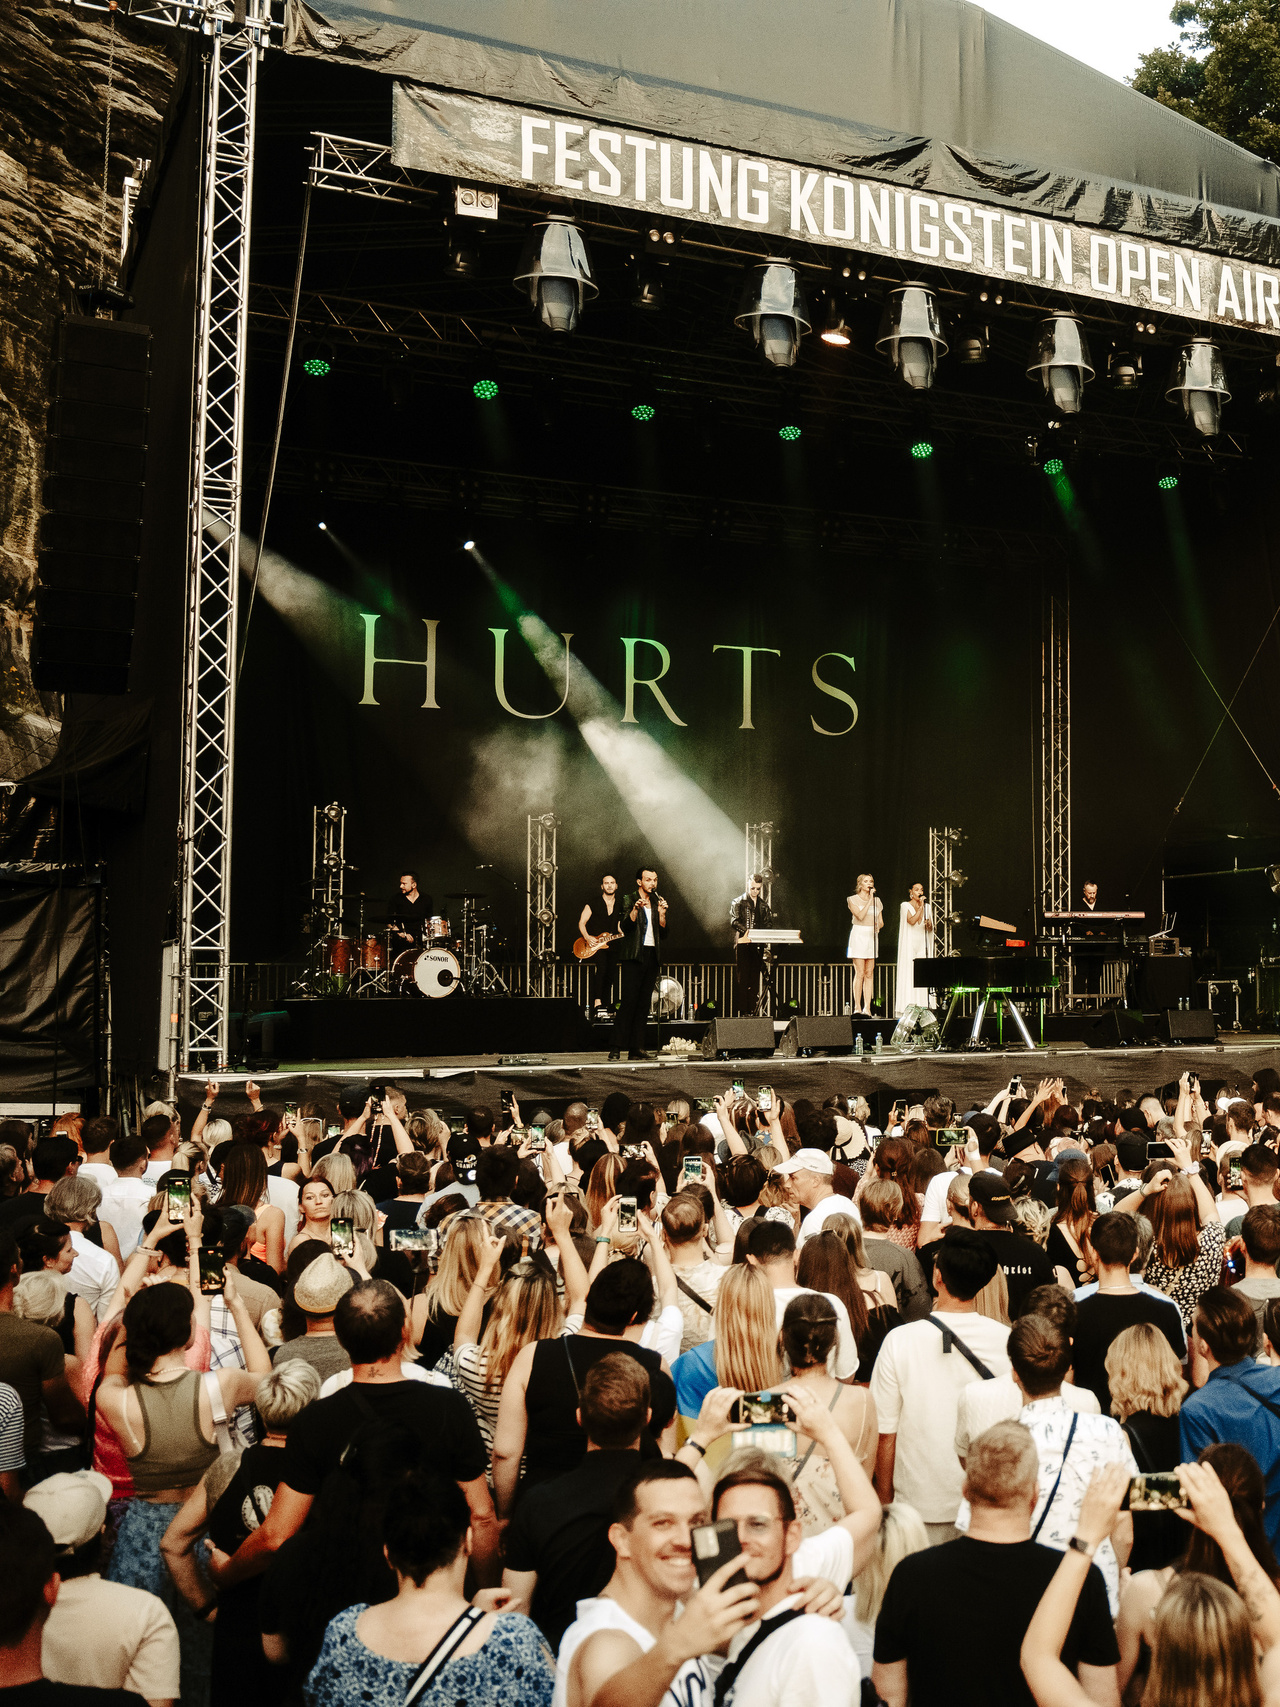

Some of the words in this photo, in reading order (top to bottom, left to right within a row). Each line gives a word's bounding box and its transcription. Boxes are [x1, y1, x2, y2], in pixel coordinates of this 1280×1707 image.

[520, 115, 769, 224] FESTUNG
[789, 168, 1073, 285] KÖNIGSTEIN
[1089, 234, 1202, 311] OPEN
[1217, 264, 1280, 329] AIR
[358, 612, 860, 737] HURTS
